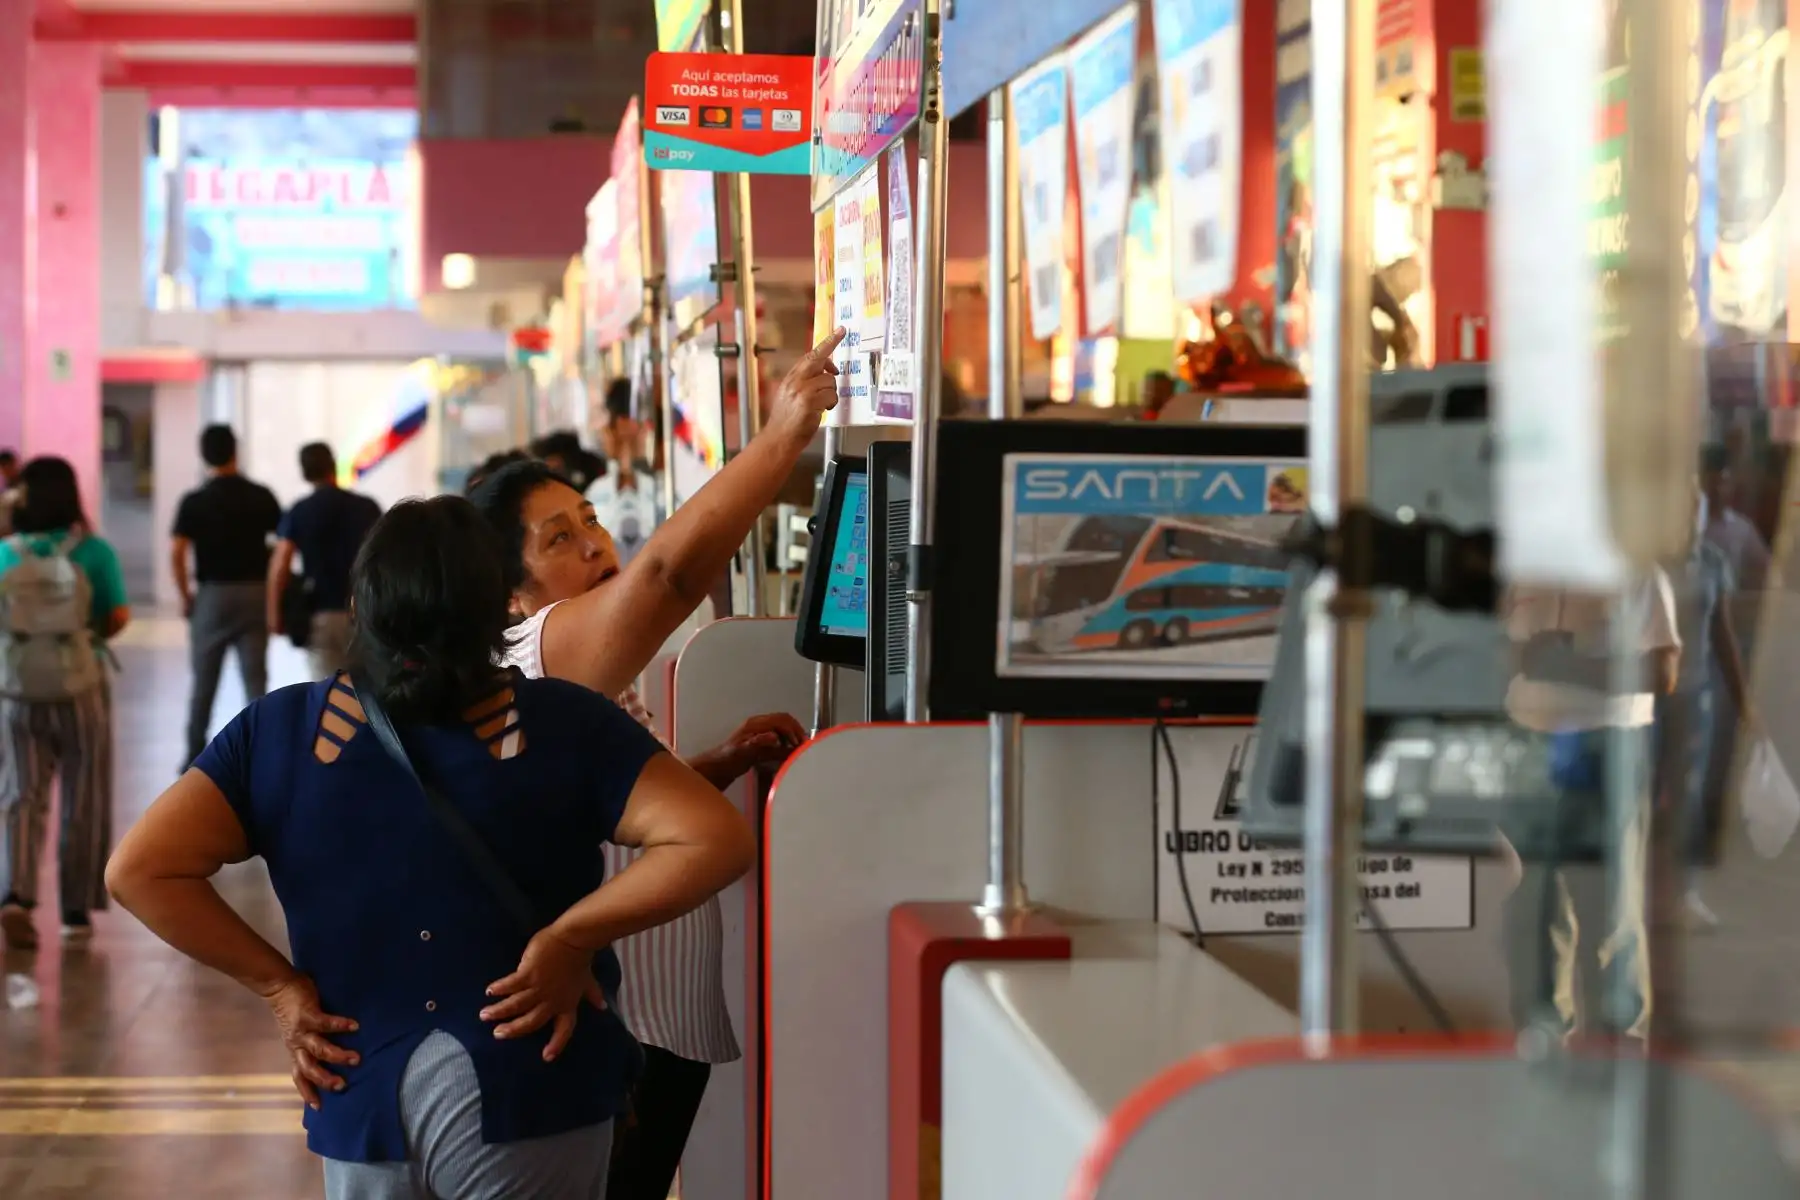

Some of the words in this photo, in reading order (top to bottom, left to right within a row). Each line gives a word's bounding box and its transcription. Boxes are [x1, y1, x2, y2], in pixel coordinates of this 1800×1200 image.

[682, 68, 710, 82] Aquí
[713, 72, 779, 84] aceptamos
[672, 84, 718, 97] TODAS
[721, 86, 739, 98] las
[742, 88, 788, 101] tarjetas
[662, 111, 686, 121] VISA
[1024, 468, 1245, 500] SANTA
[1166, 830, 1230, 853] LIBRO
[1217, 861, 1246, 877] Ley
[1392, 856, 1412, 872] de
[1395, 881, 1420, 898] del
